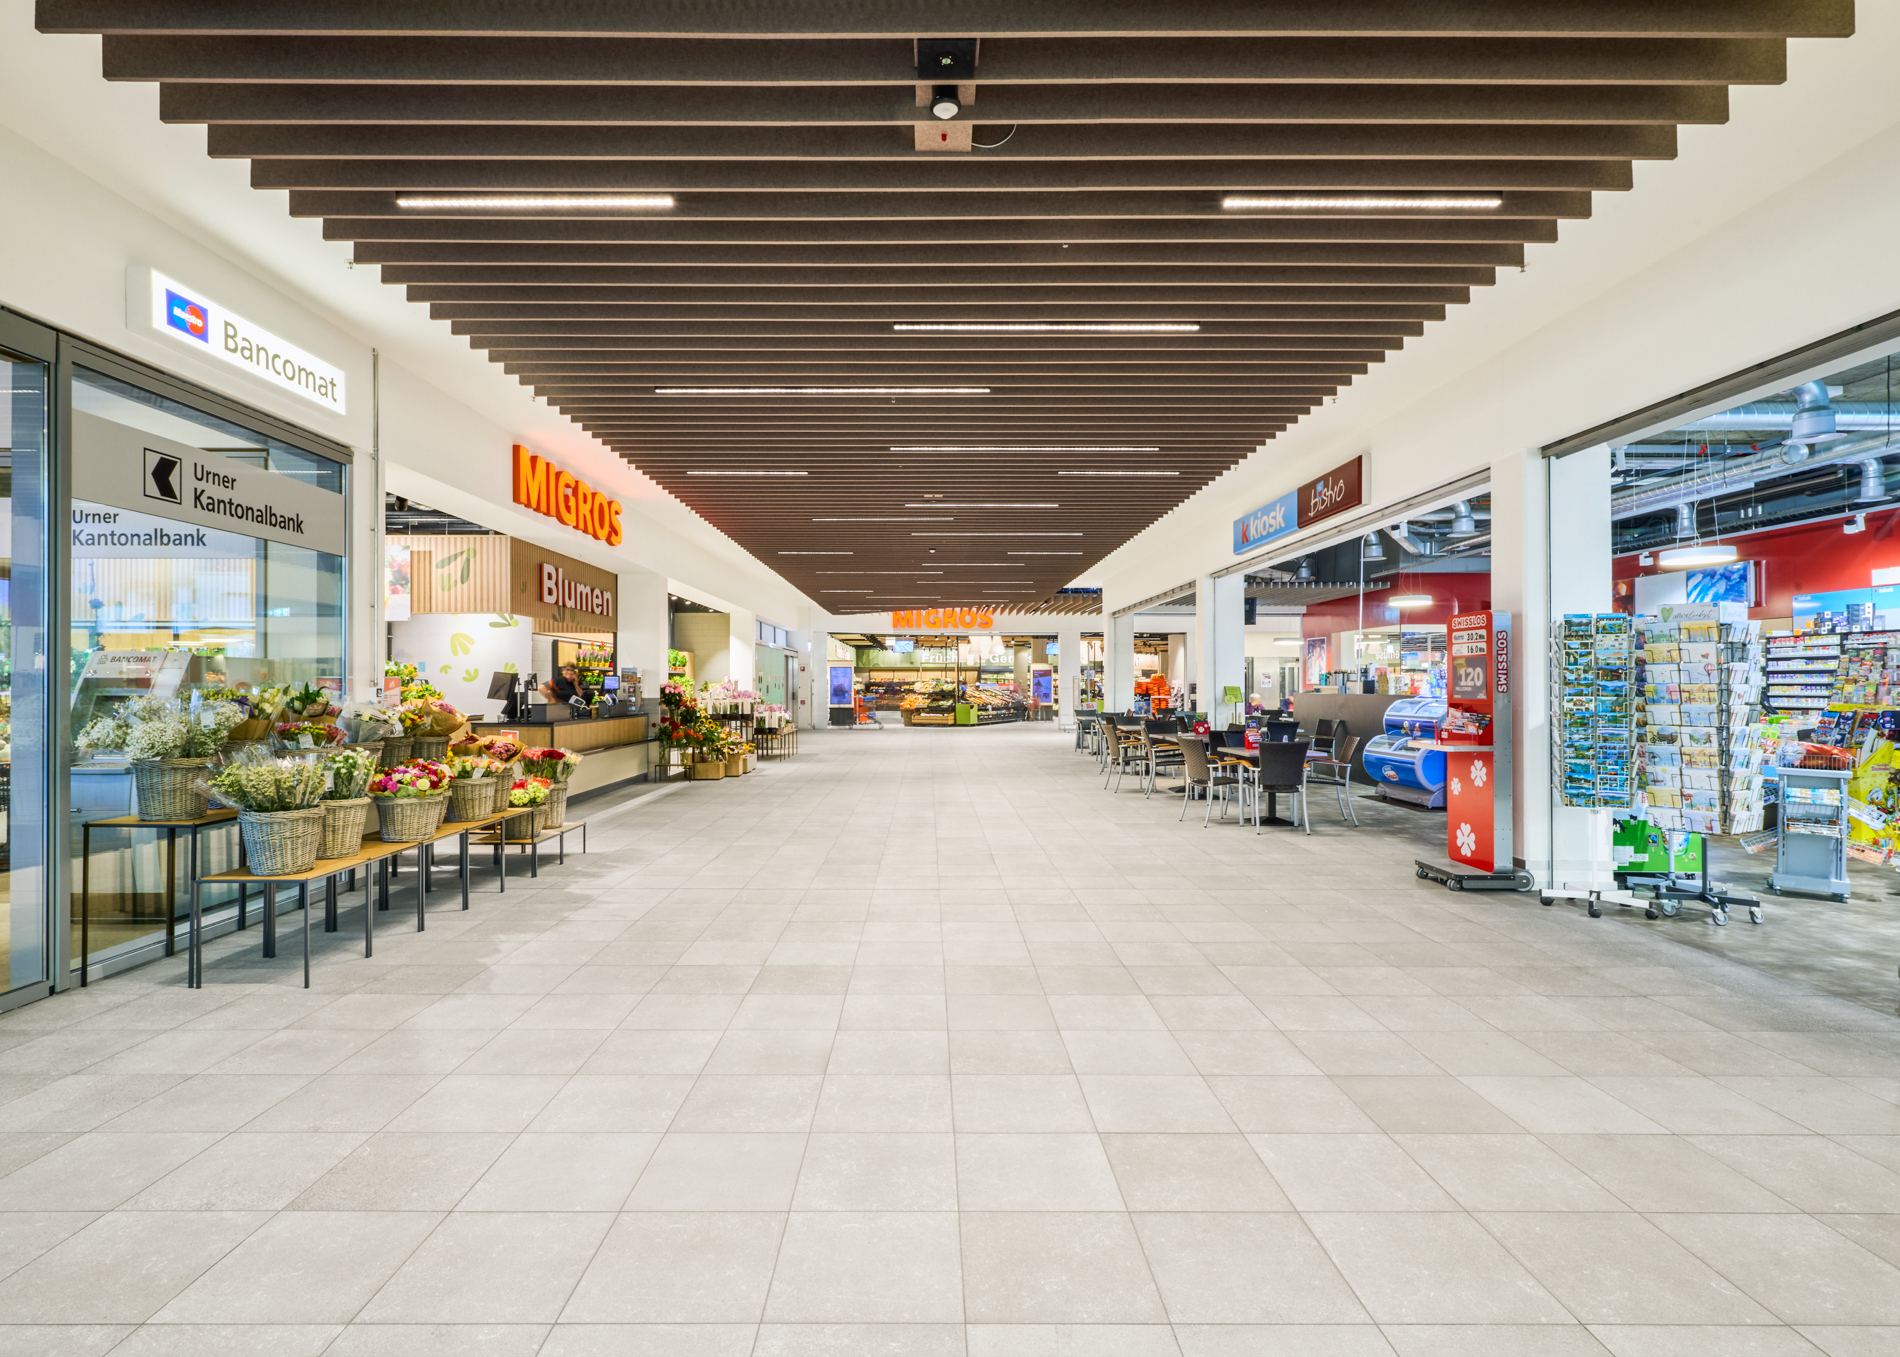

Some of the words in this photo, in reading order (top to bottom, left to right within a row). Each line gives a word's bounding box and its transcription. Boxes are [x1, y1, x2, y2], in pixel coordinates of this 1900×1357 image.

[173, 306, 204, 328] Maestro
[223, 319, 337, 403] Bancomat
[193, 462, 237, 490] Urner
[512, 444, 622, 546] MIGROS
[1308, 476, 1345, 518] bistro
[72, 509, 120, 524] Urner
[193, 487, 304, 534] Kantonalbank
[1250, 502, 1286, 541] kiosk
[72, 528, 207, 547] Kantonalbank
[541, 562, 613, 617] Blumen
[892, 609, 994, 629] MIGROS
[1452, 615, 1486, 628] SWISSLOS
[110, 656, 158, 664] BANCOMAT
[1497, 631, 1508, 693] SWISSLOS
[1460, 667, 1483, 686] 120
